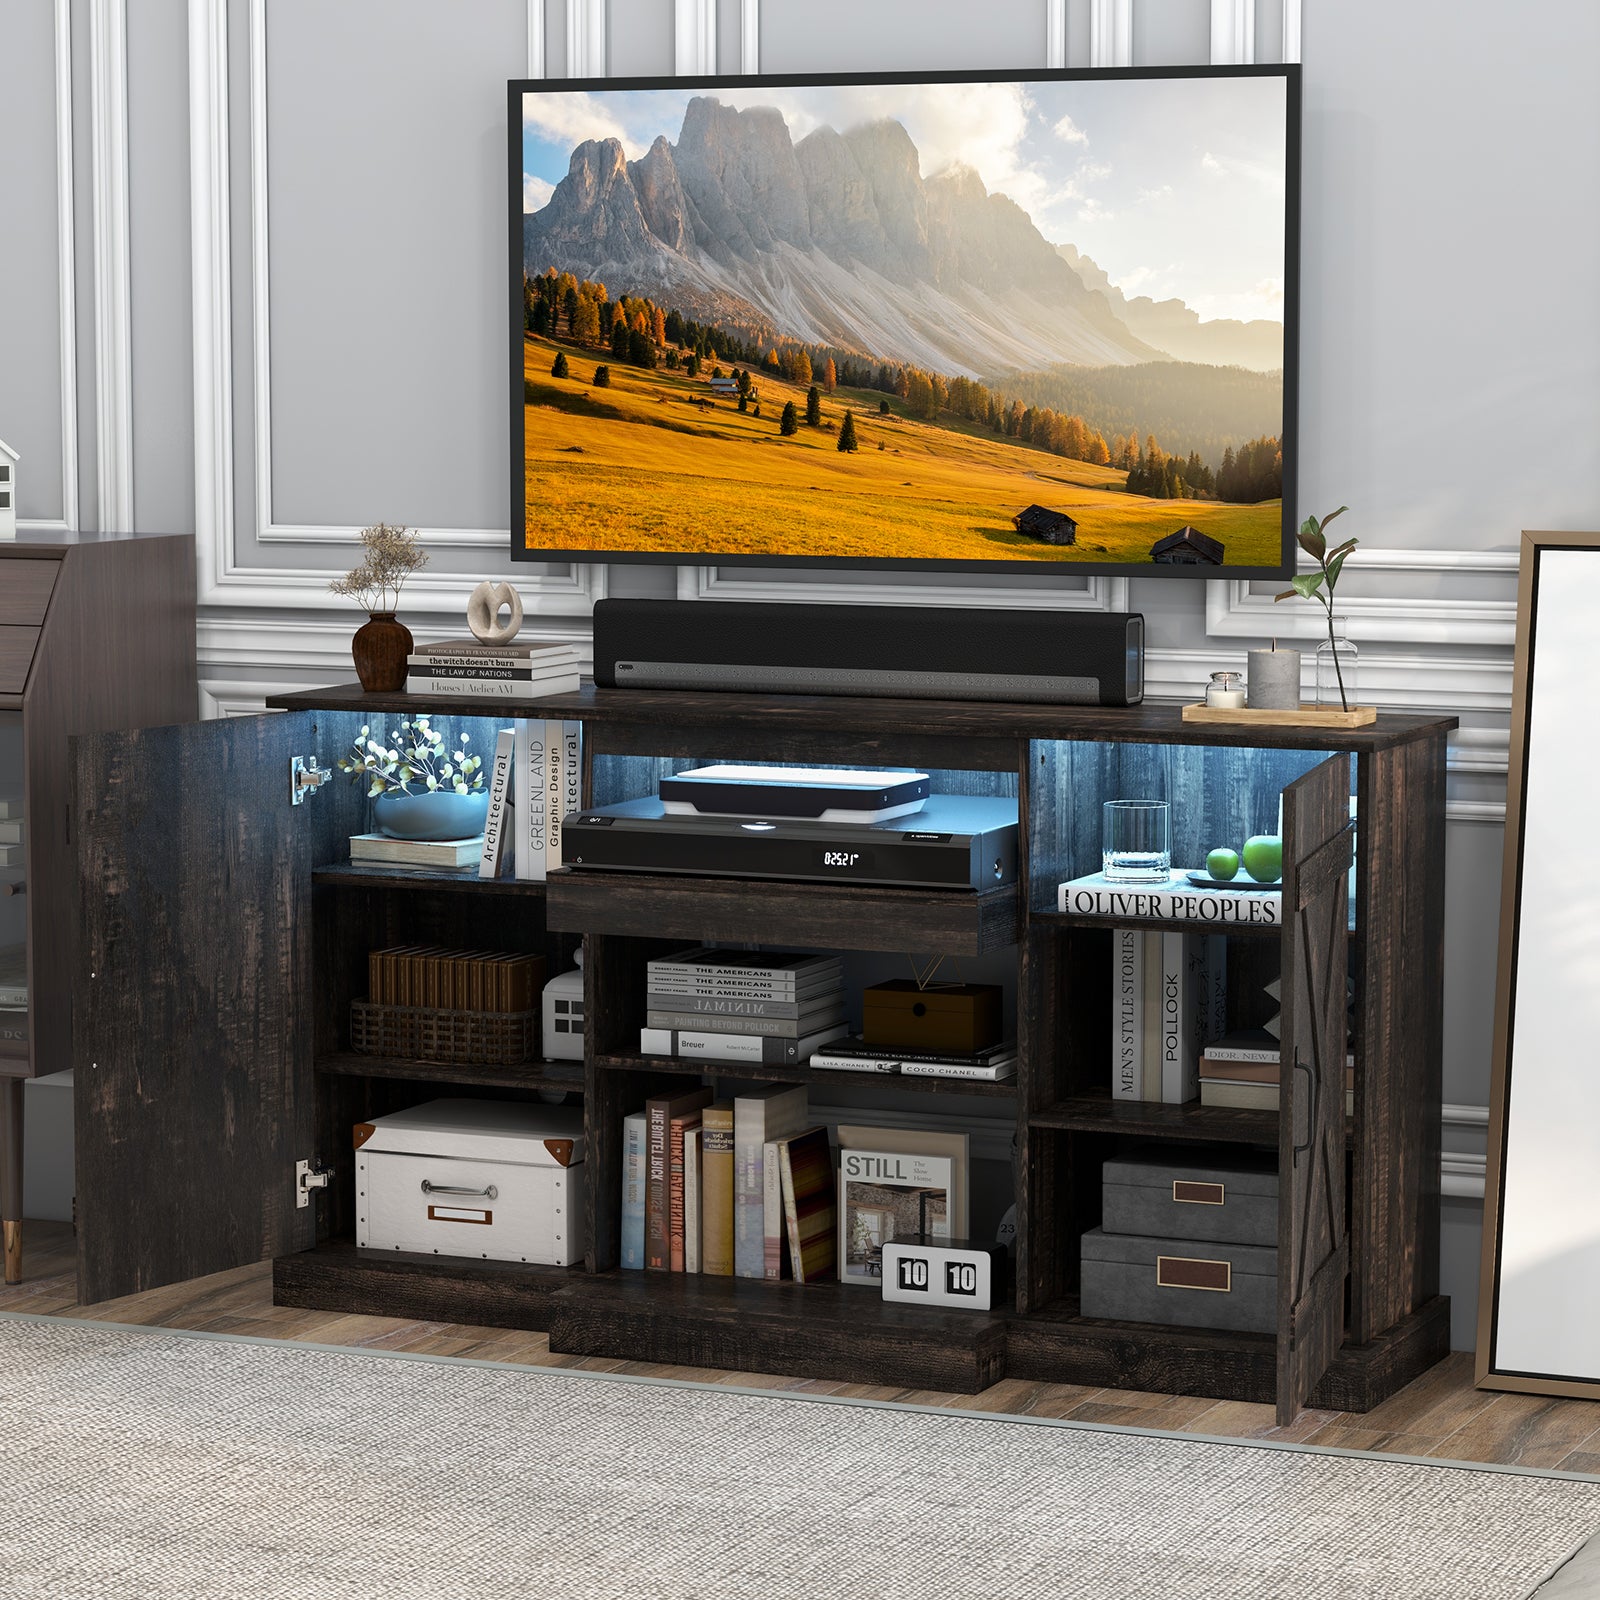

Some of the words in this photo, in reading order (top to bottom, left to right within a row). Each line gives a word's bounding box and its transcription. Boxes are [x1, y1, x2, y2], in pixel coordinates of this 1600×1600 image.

[431, 668, 446, 676] THE
[479, 670, 513, 678] NATIONS
[466, 658, 494, 666] doesn't
[496, 659, 515, 667] burn
[431, 682, 461, 692] Houses
[466, 683, 496, 693] Atelier
[496, 684, 513, 694] AM
[550, 747, 560, 792] Design
[530, 740, 544, 851] GREENLAND
[483, 754, 508, 862] Architectural
[550, 796, 559, 848] Graphic
[1074, 890, 1164, 918] OLIVER
[1170, 896, 1276, 924] PEOPLES
[716, 969, 772, 978] AMERICANS
[1122, 931, 1134, 995] STORIES
[716, 979, 772, 988] AMERICANS
[716, 989, 772, 998] AMERICANS
[674, 1016, 710, 1028] PAINTING
[712, 1019, 744, 1030] BEYOND
[744, 1021, 780, 1033] POLLOCK
[1121, 998, 1134, 1044] STYLE
[1166, 974, 1178, 1062] POLLOCK
[682, 1040, 705, 1049] Breuer
[1242, 1052, 1268, 1060] NEW
[938, 1068, 977, 1076] CHANEL
[1121, 1047, 1134, 1093] MEN'S
[846, 1156, 908, 1180] STILL
[900, 1261, 927, 1286] 10
[949, 1266, 976, 1291] 10
